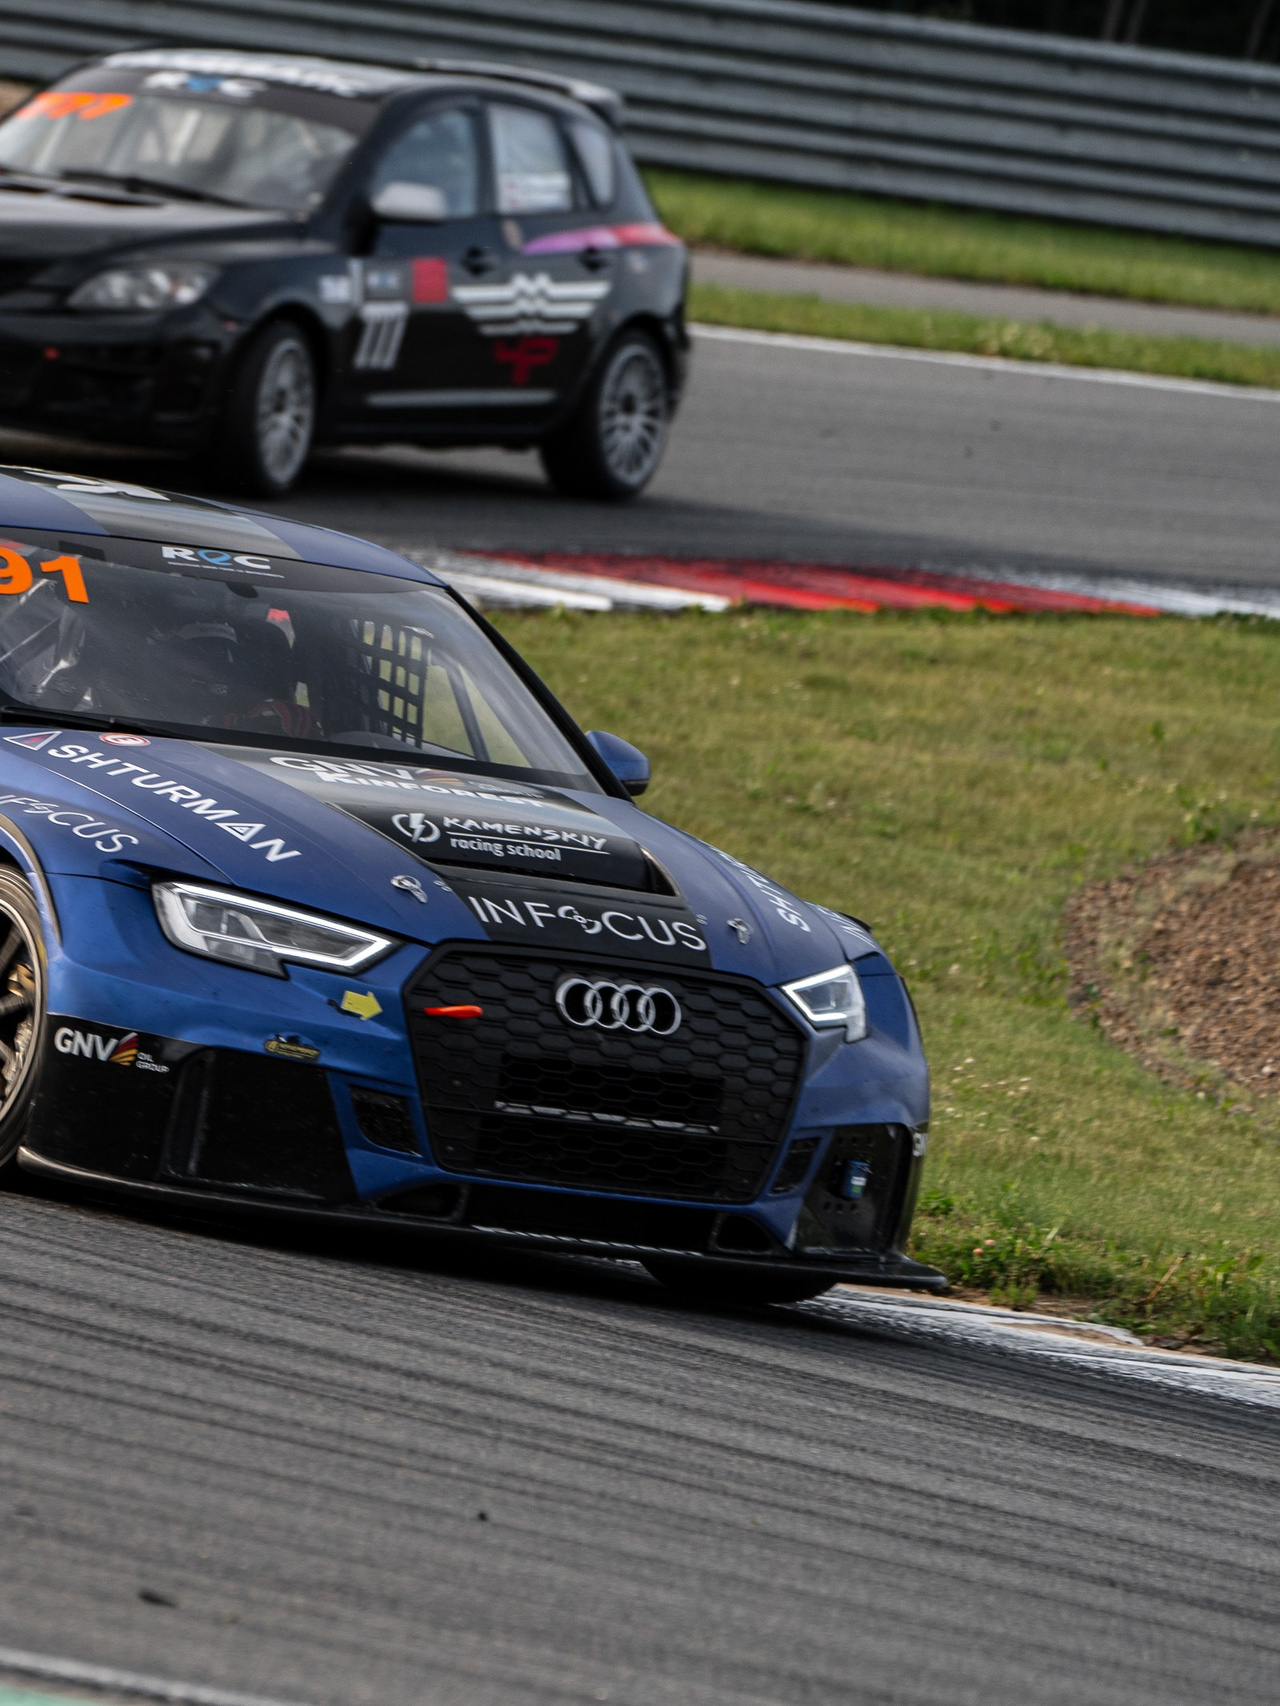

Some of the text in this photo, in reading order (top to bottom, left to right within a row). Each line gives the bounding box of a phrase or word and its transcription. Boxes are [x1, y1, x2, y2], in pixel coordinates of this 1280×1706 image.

[268, 756, 414, 782] GNV
[47, 744, 303, 863] SHTURMAN
[314, 771, 543, 808] KINFOREST
[442, 816, 608, 851] KAMENSKIY
[450, 836, 562, 862] racing school
[54, 1026, 119, 1062] GNV
